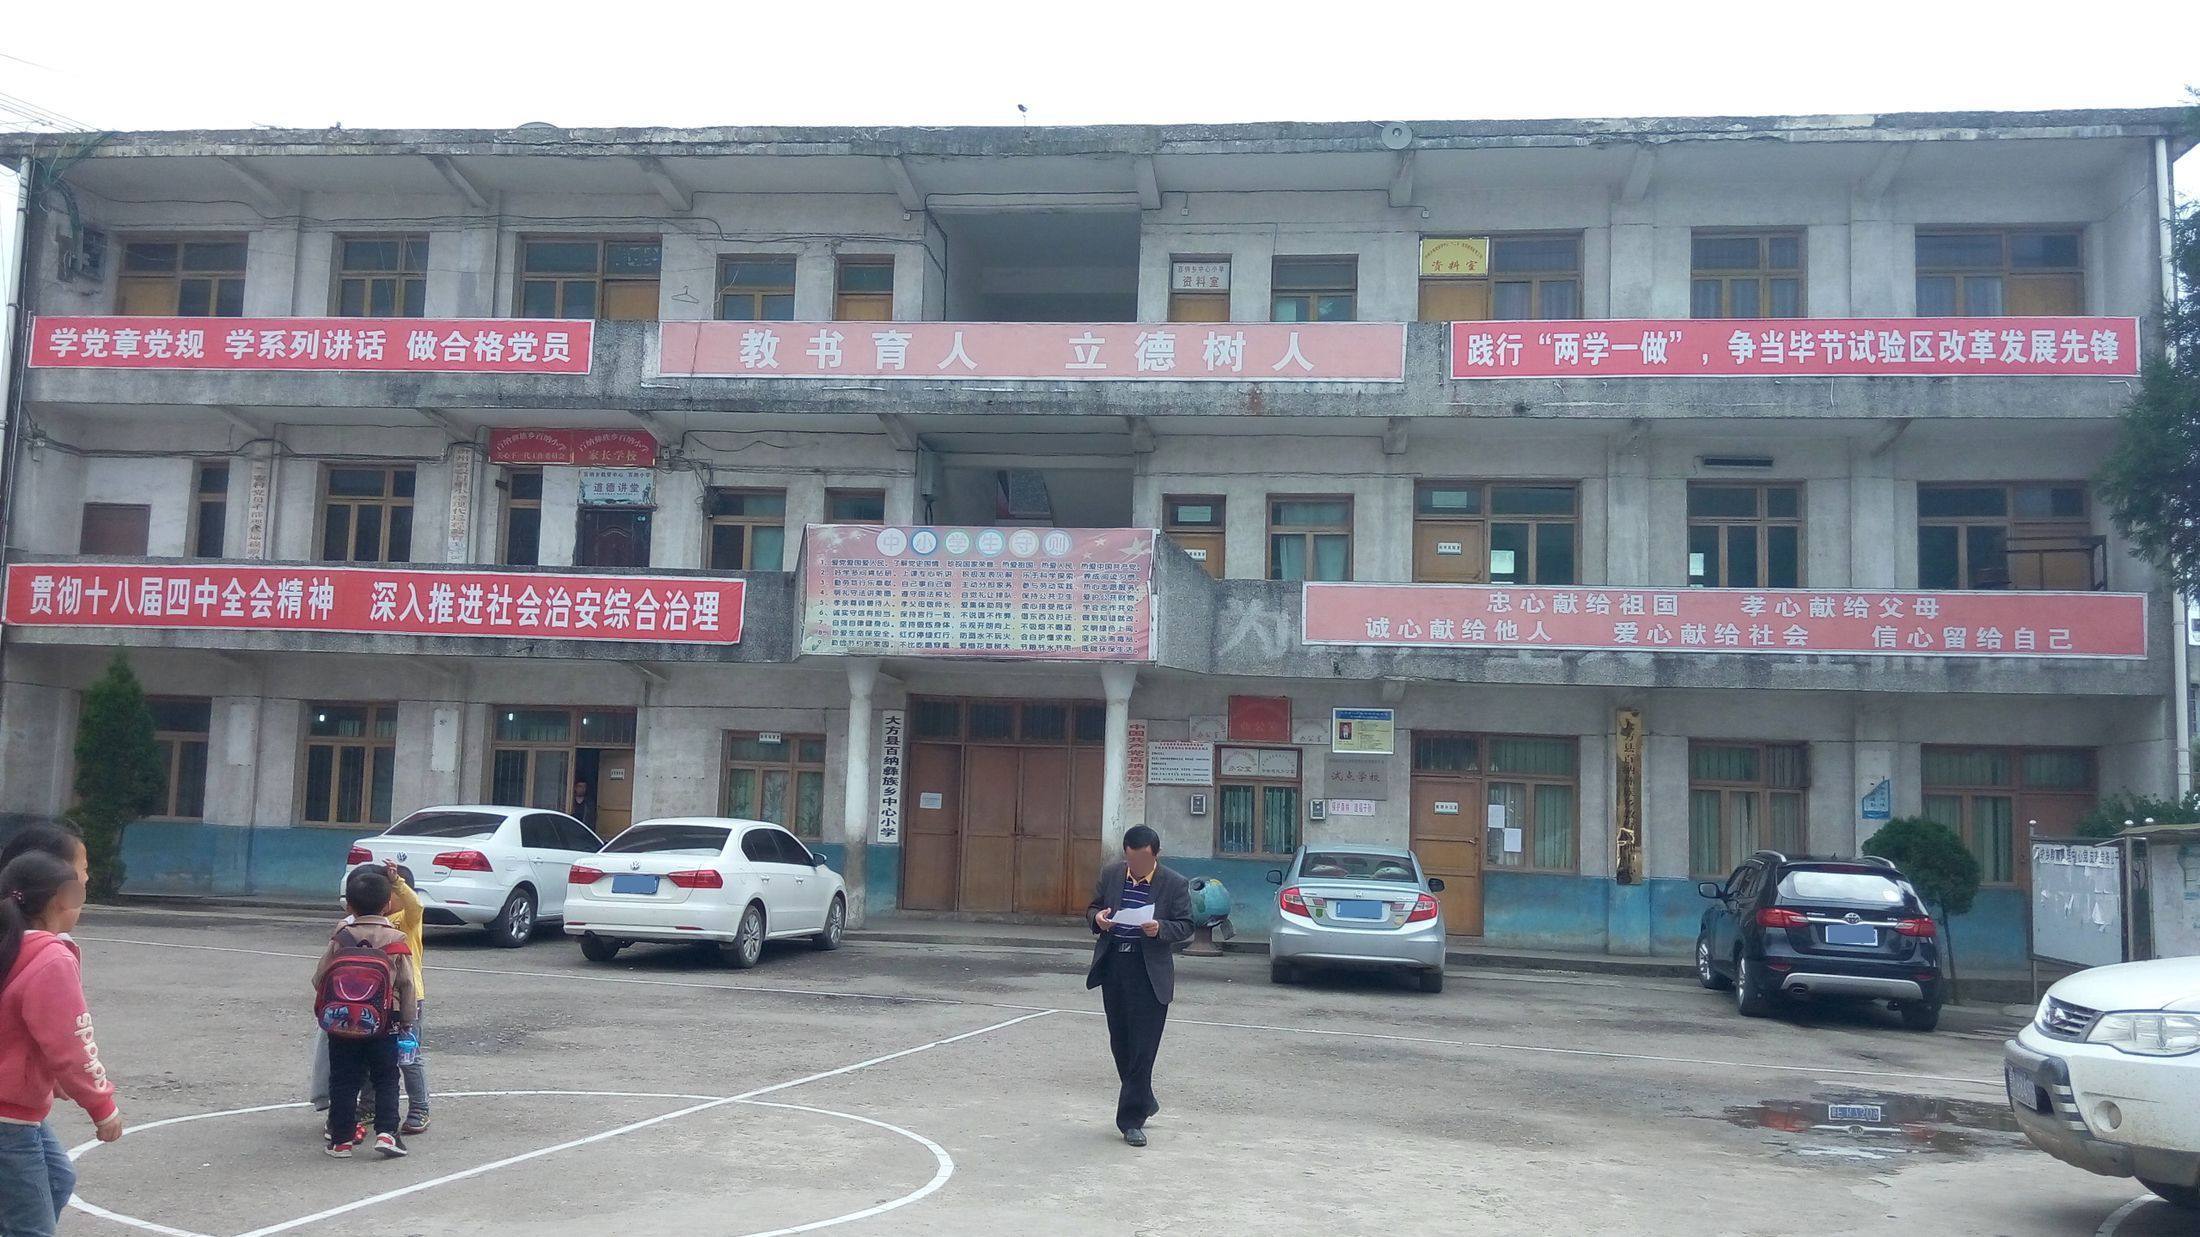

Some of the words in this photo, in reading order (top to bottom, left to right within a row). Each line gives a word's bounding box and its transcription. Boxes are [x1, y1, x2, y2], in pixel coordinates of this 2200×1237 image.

[1182, 276, 1220, 288] 资料室
[48, 328, 206, 360] 学党章党规
[224, 329, 387, 362] 学系列讲话
[406, 330, 571, 364] 做合格党员
[738, 327, 978, 371] 教书育人
[1065, 331, 1315, 373] 立德树人
[589, 450, 638, 462] 家长学校
[593, 482, 641, 493] 道德讲堂
[881, 531, 1068, 555] 中小学生守则
[30, 575, 335, 622] 贯彻十八届四中全会精神
[369, 581, 721, 632] 深入推进社会治安综合治理
[1486, 592, 1680, 617] 忠心献给祖国
[1740, 595, 1941, 620] 孝心献给父母
[1365, 617, 1553, 643] 诚心献给他人
[1613, 621, 1810, 647] 爱心献给社会
[1871, 625, 2075, 651] 信心留给自己
[879, 715, 902, 838] 大方县百纳彝族乡中心小学
